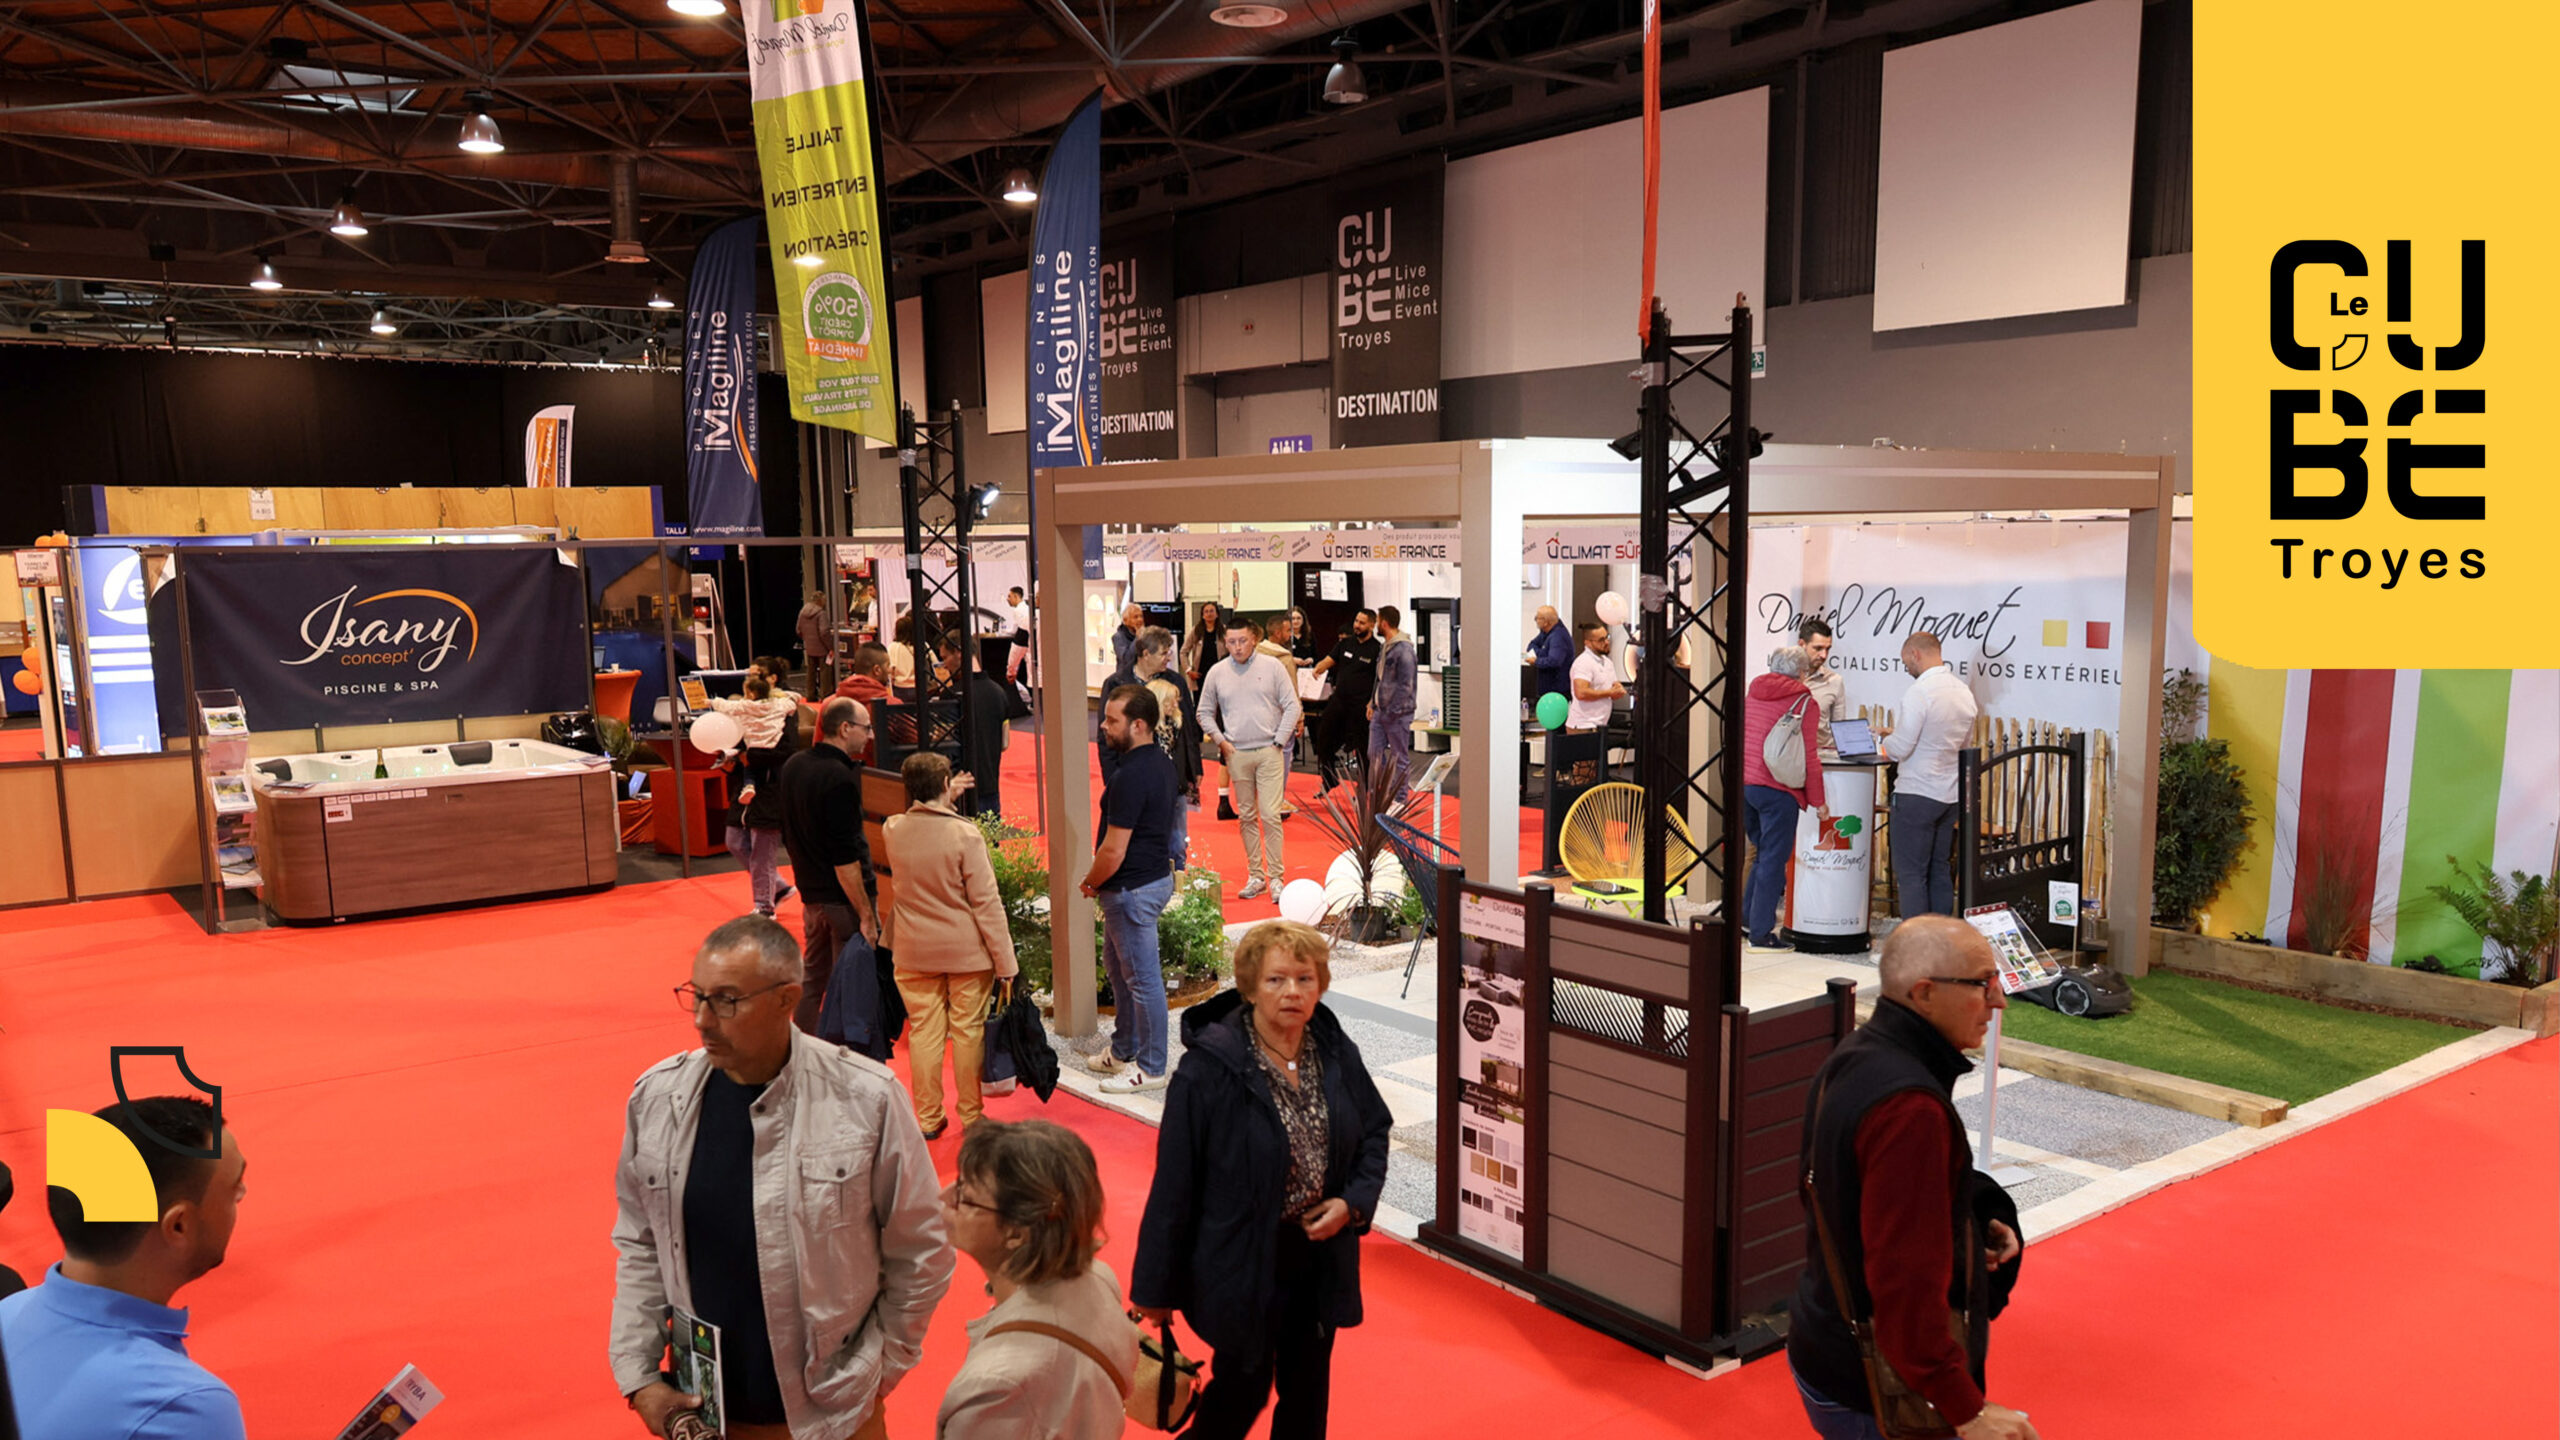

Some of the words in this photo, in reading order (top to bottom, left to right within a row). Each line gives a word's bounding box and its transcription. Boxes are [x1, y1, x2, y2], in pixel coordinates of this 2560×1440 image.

[1395, 264, 1427, 281] Live
[1089, 246, 1097, 319] PASSION
[1395, 283, 1430, 300] Mice
[1140, 307, 1162, 320] Live
[1395, 299, 1438, 320] Event
[1140, 323, 1165, 336] Mice
[1088, 330, 1096, 361] PAR
[1140, 336, 1172, 352] Event
[1338, 329, 1391, 350] Troyes
[1036, 254, 1046, 452] PISCINES
[1100, 361, 1138, 378] Troyes
[692, 312, 702, 451] PISCINES
[1089, 372, 1098, 450] PISCINES
[1337, 388, 1438, 419] DESTINATION
[1100, 410, 1174, 435] DESTINATION
[694, 525, 761, 536] www.magiline.com
[1102, 545, 1128, 555] ANCE
[1172, 549, 1206, 560] RESEAU
[1227, 548, 1261, 559] FRANCE
[1335, 545, 1372, 559] DISTRI
[1373, 542, 1397, 559] SÛR
[1400, 545, 1446, 559] FRANCE
[1561, 545, 1612, 559] CLIMAT
[280, 584, 462, 673] Isany
[1758, 583, 1864, 639] Daniel
[1867, 586, 2023, 659] Moquet
[1828, 655, 1910, 673] CIALISTE
[1943, 660, 1968, 676] DE
[1977, 662, 2015, 678] VOS
[2024, 663, 2122, 686] EXTÉRIEU
[324, 682, 387, 696] PISCINE
[394, 682, 404, 692] &
[410, 680, 439, 692] SPA
